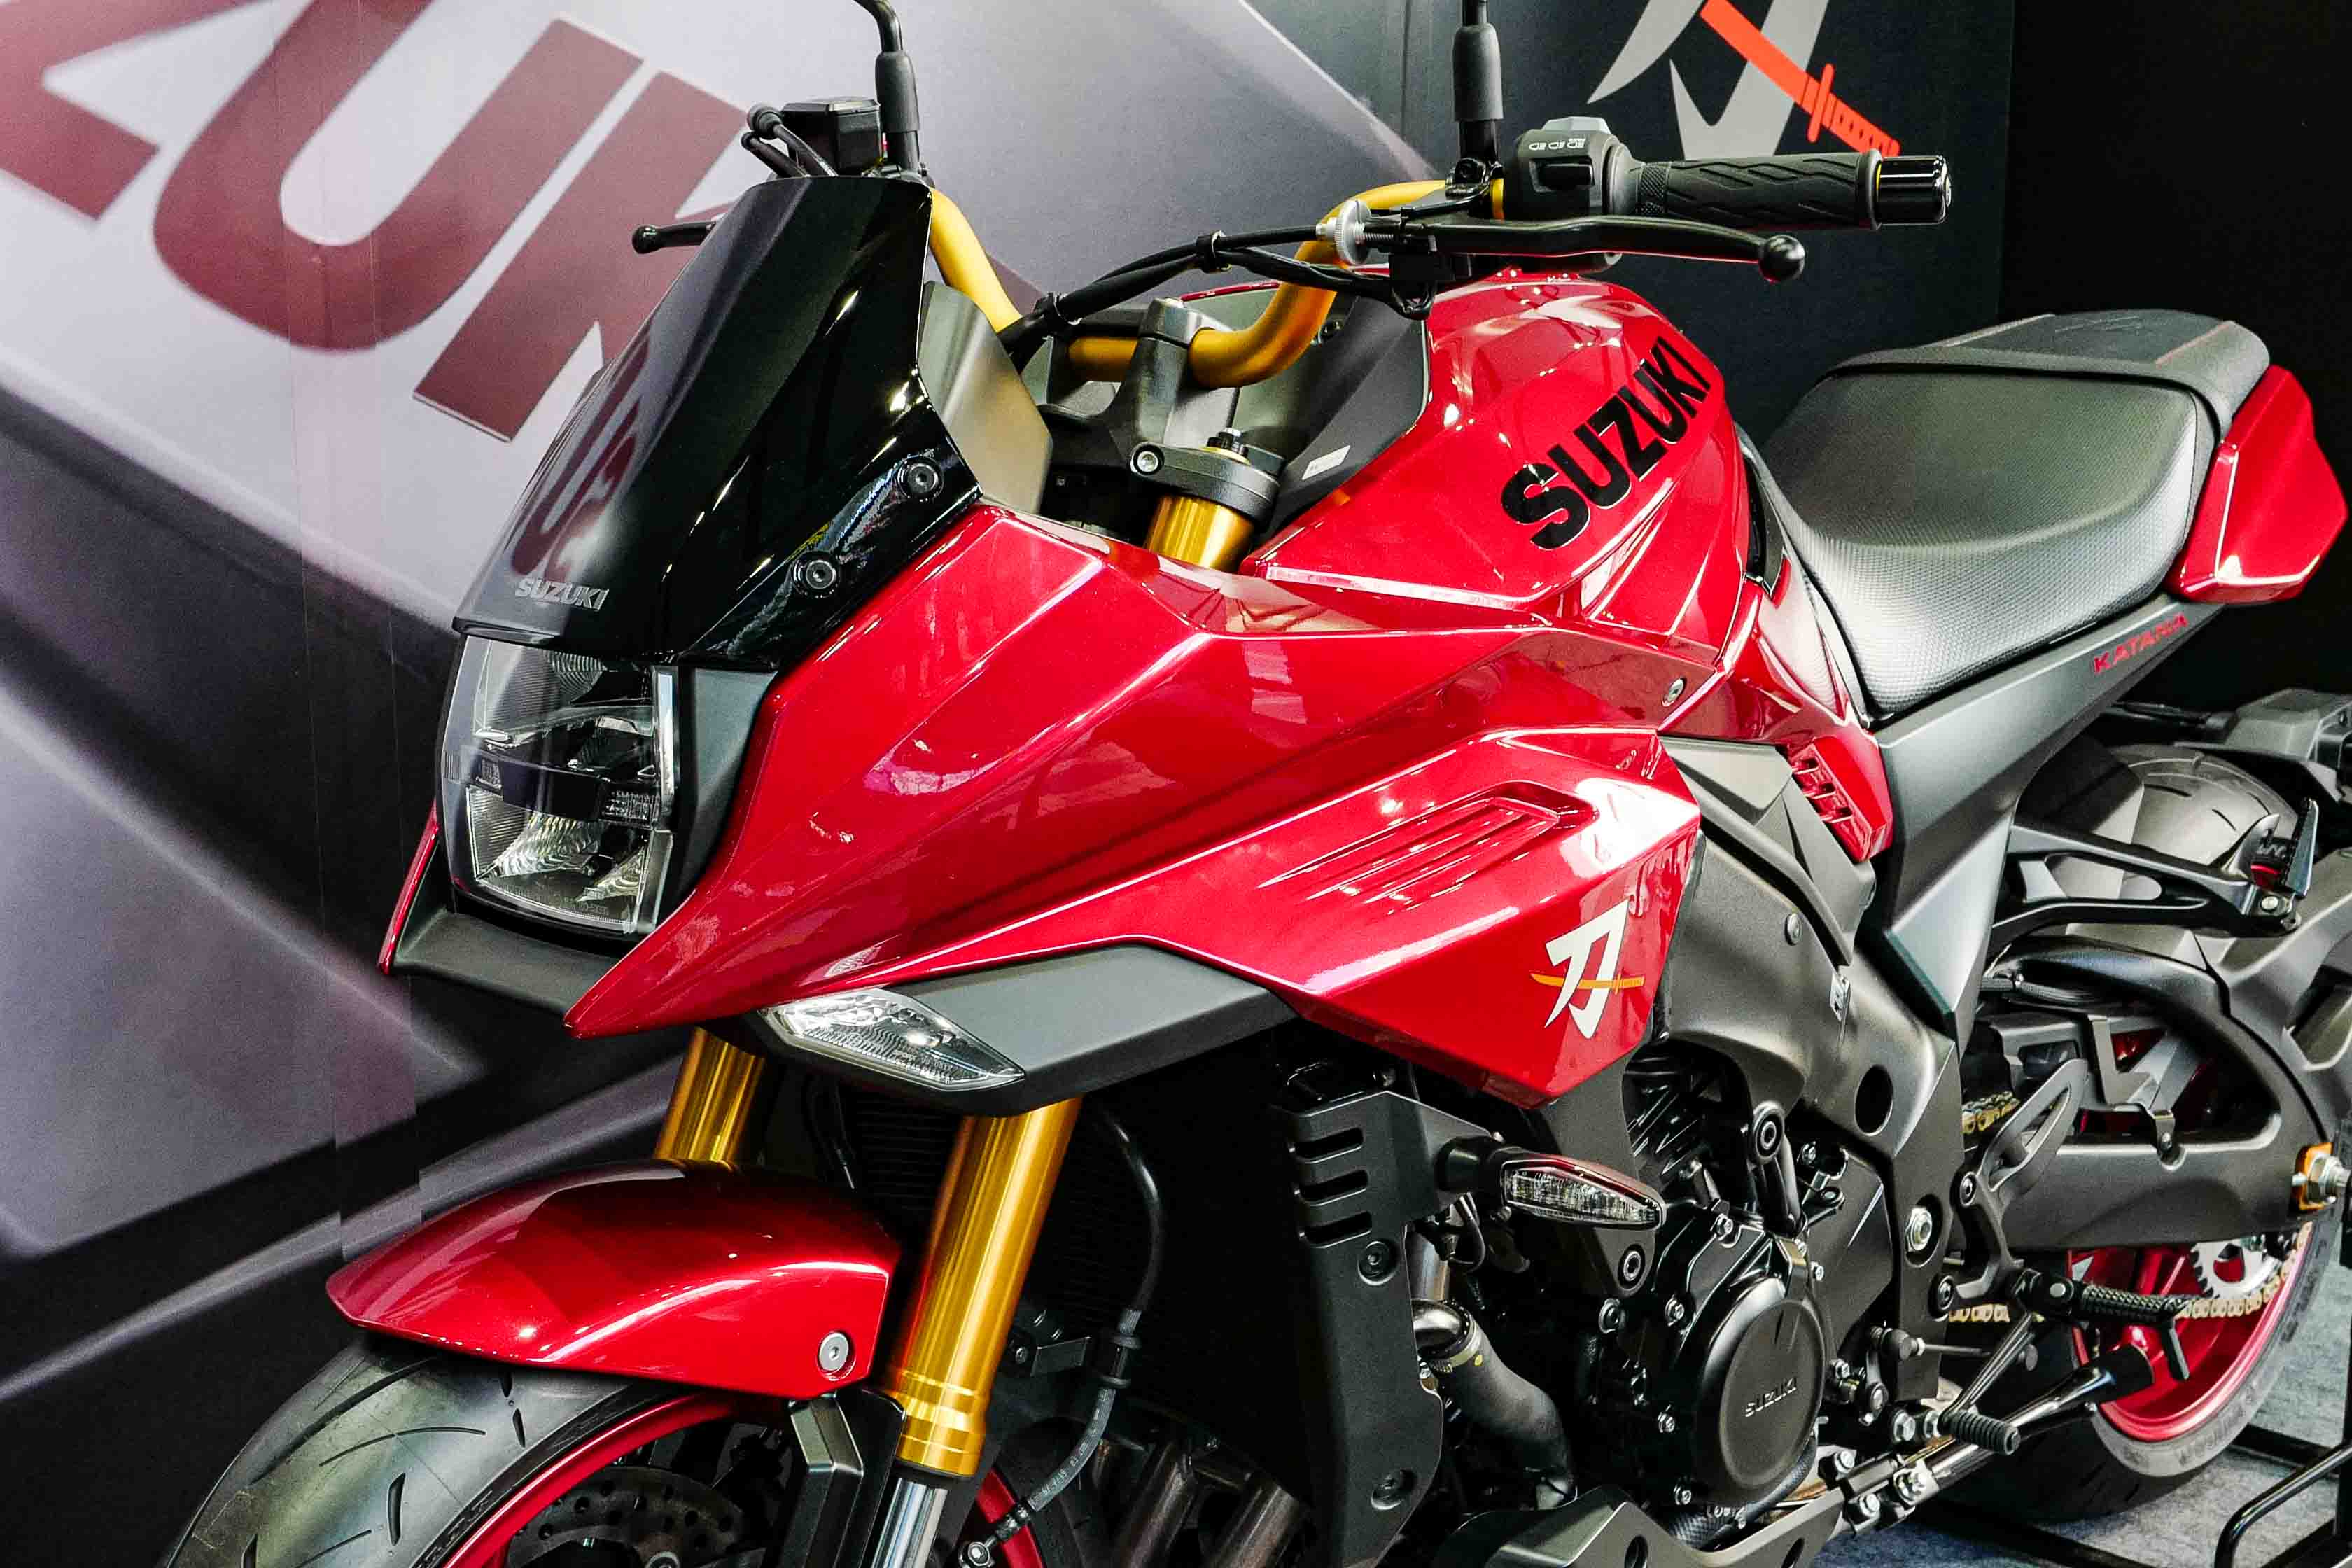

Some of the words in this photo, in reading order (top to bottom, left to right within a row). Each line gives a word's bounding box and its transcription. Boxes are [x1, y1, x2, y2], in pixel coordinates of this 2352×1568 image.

[1500, 336, 1711, 550] SUZUKI
[514, 577, 610, 613] SUZUKI
[2093, 612, 2190, 674] KATANA
[1743, 1377, 1799, 1418] SUZUKI
